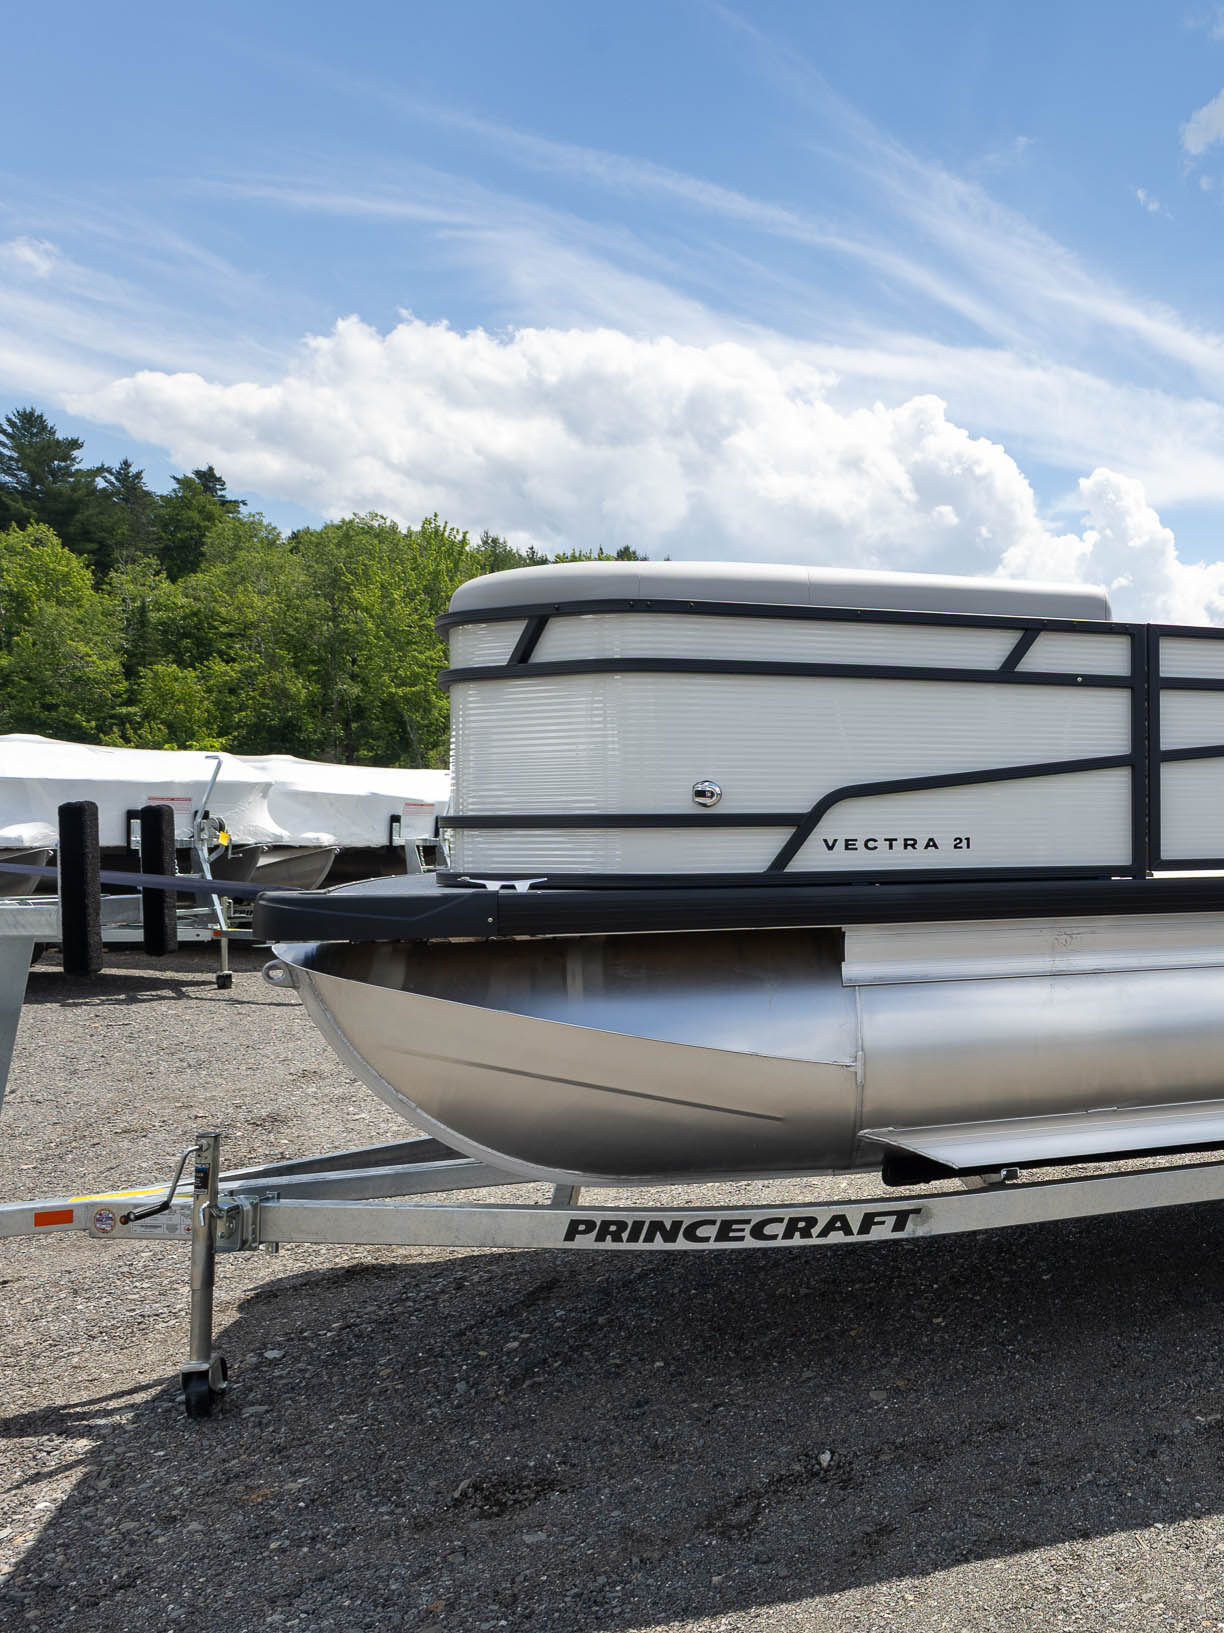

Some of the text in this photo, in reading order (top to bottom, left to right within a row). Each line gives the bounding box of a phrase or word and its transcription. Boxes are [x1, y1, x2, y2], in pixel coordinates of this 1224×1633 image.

[823, 837, 971, 851] VECTRA 21
[563, 1208, 922, 1244] PRINCECRAFT
